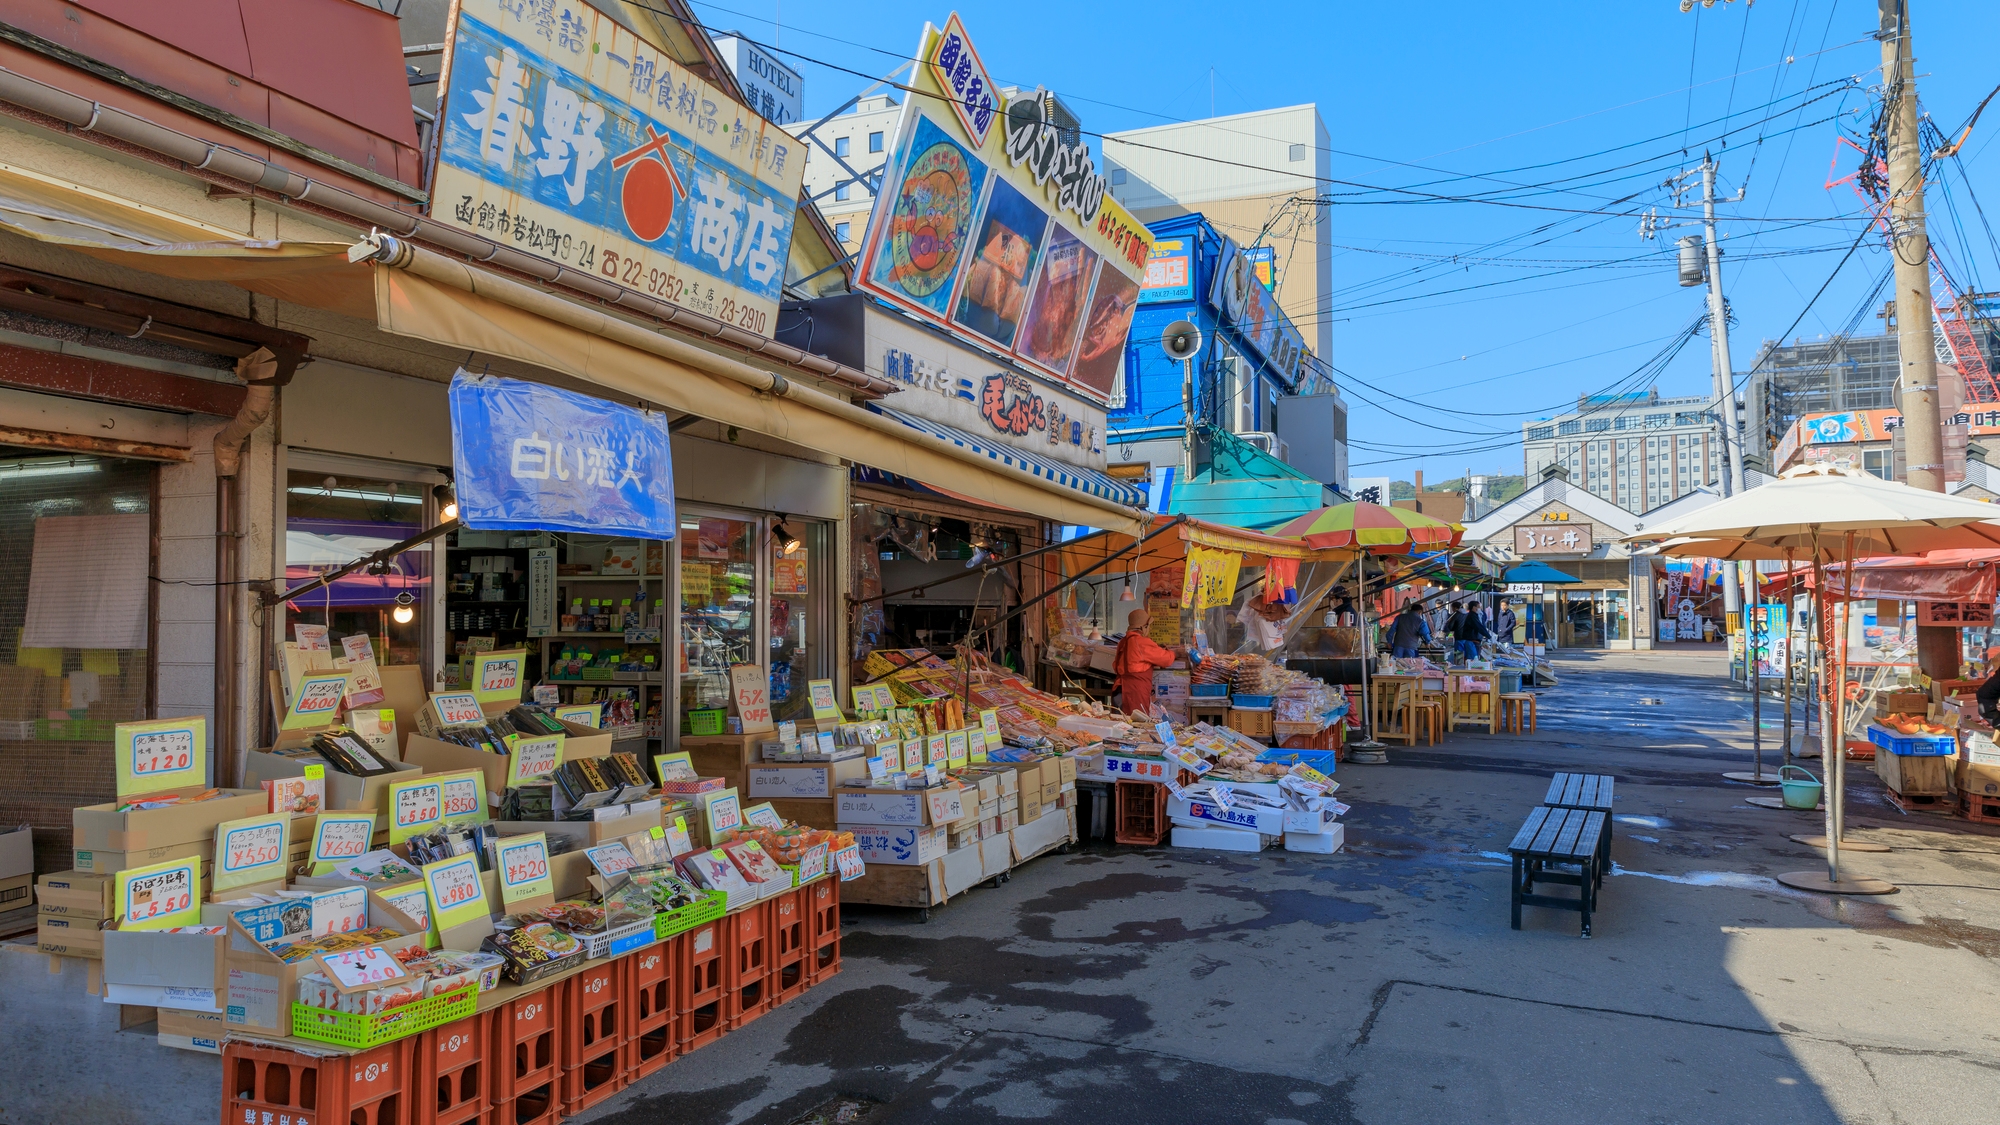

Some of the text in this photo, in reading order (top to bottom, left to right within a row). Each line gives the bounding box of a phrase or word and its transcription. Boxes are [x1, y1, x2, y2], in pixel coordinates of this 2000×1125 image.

[748, 49, 794, 97] HOTEL
[462, 47, 784, 285] 春野 商店
[456, 195, 766, 333] 函館市若松町9-24 22-9252 支店 23-2910
[1143, 260, 1183, 286] 商店
[887, 350, 975, 401] 函館カネニ
[982, 373, 1045, 436] 毛がに
[1806, 448, 1830, 458] 2F
[511, 432, 642, 493] 白い恋人
[483, 678, 515, 689] ¥1200
[736, 673, 761, 683] 白い恋人
[299, 698, 336, 711] ¥600
[739, 689, 764, 706] 5%
[447, 710, 480, 721] ¥600
[744, 709, 769, 722] OFF
[137, 734, 191, 745] 北海道ラーメン
[138, 753, 188, 771] ¥120
[756, 777, 787, 785] 白い恋人
[400, 806, 436, 823] ¥550
[444, 798, 476, 814] ¥850
[842, 802, 876, 812] 白い恋人
[933, 798, 949, 819] 5%
[1217, 810, 1257, 825] 小島水産
[326, 823, 367, 833] とろろ昆布
[233, 845, 278, 868] ¥550
[323, 841, 364, 857] ¥650
[508, 860, 547, 883] ¥520
[604, 857, 637, 874] ¥350
[132, 871, 185, 892] おぼろ昆布
[442, 883, 473, 904] ¥980
[132, 893, 190, 920] ¥550
[327, 913, 365, 934] 180
[339, 947, 376, 964] 270
[358, 967, 396, 983] 240
